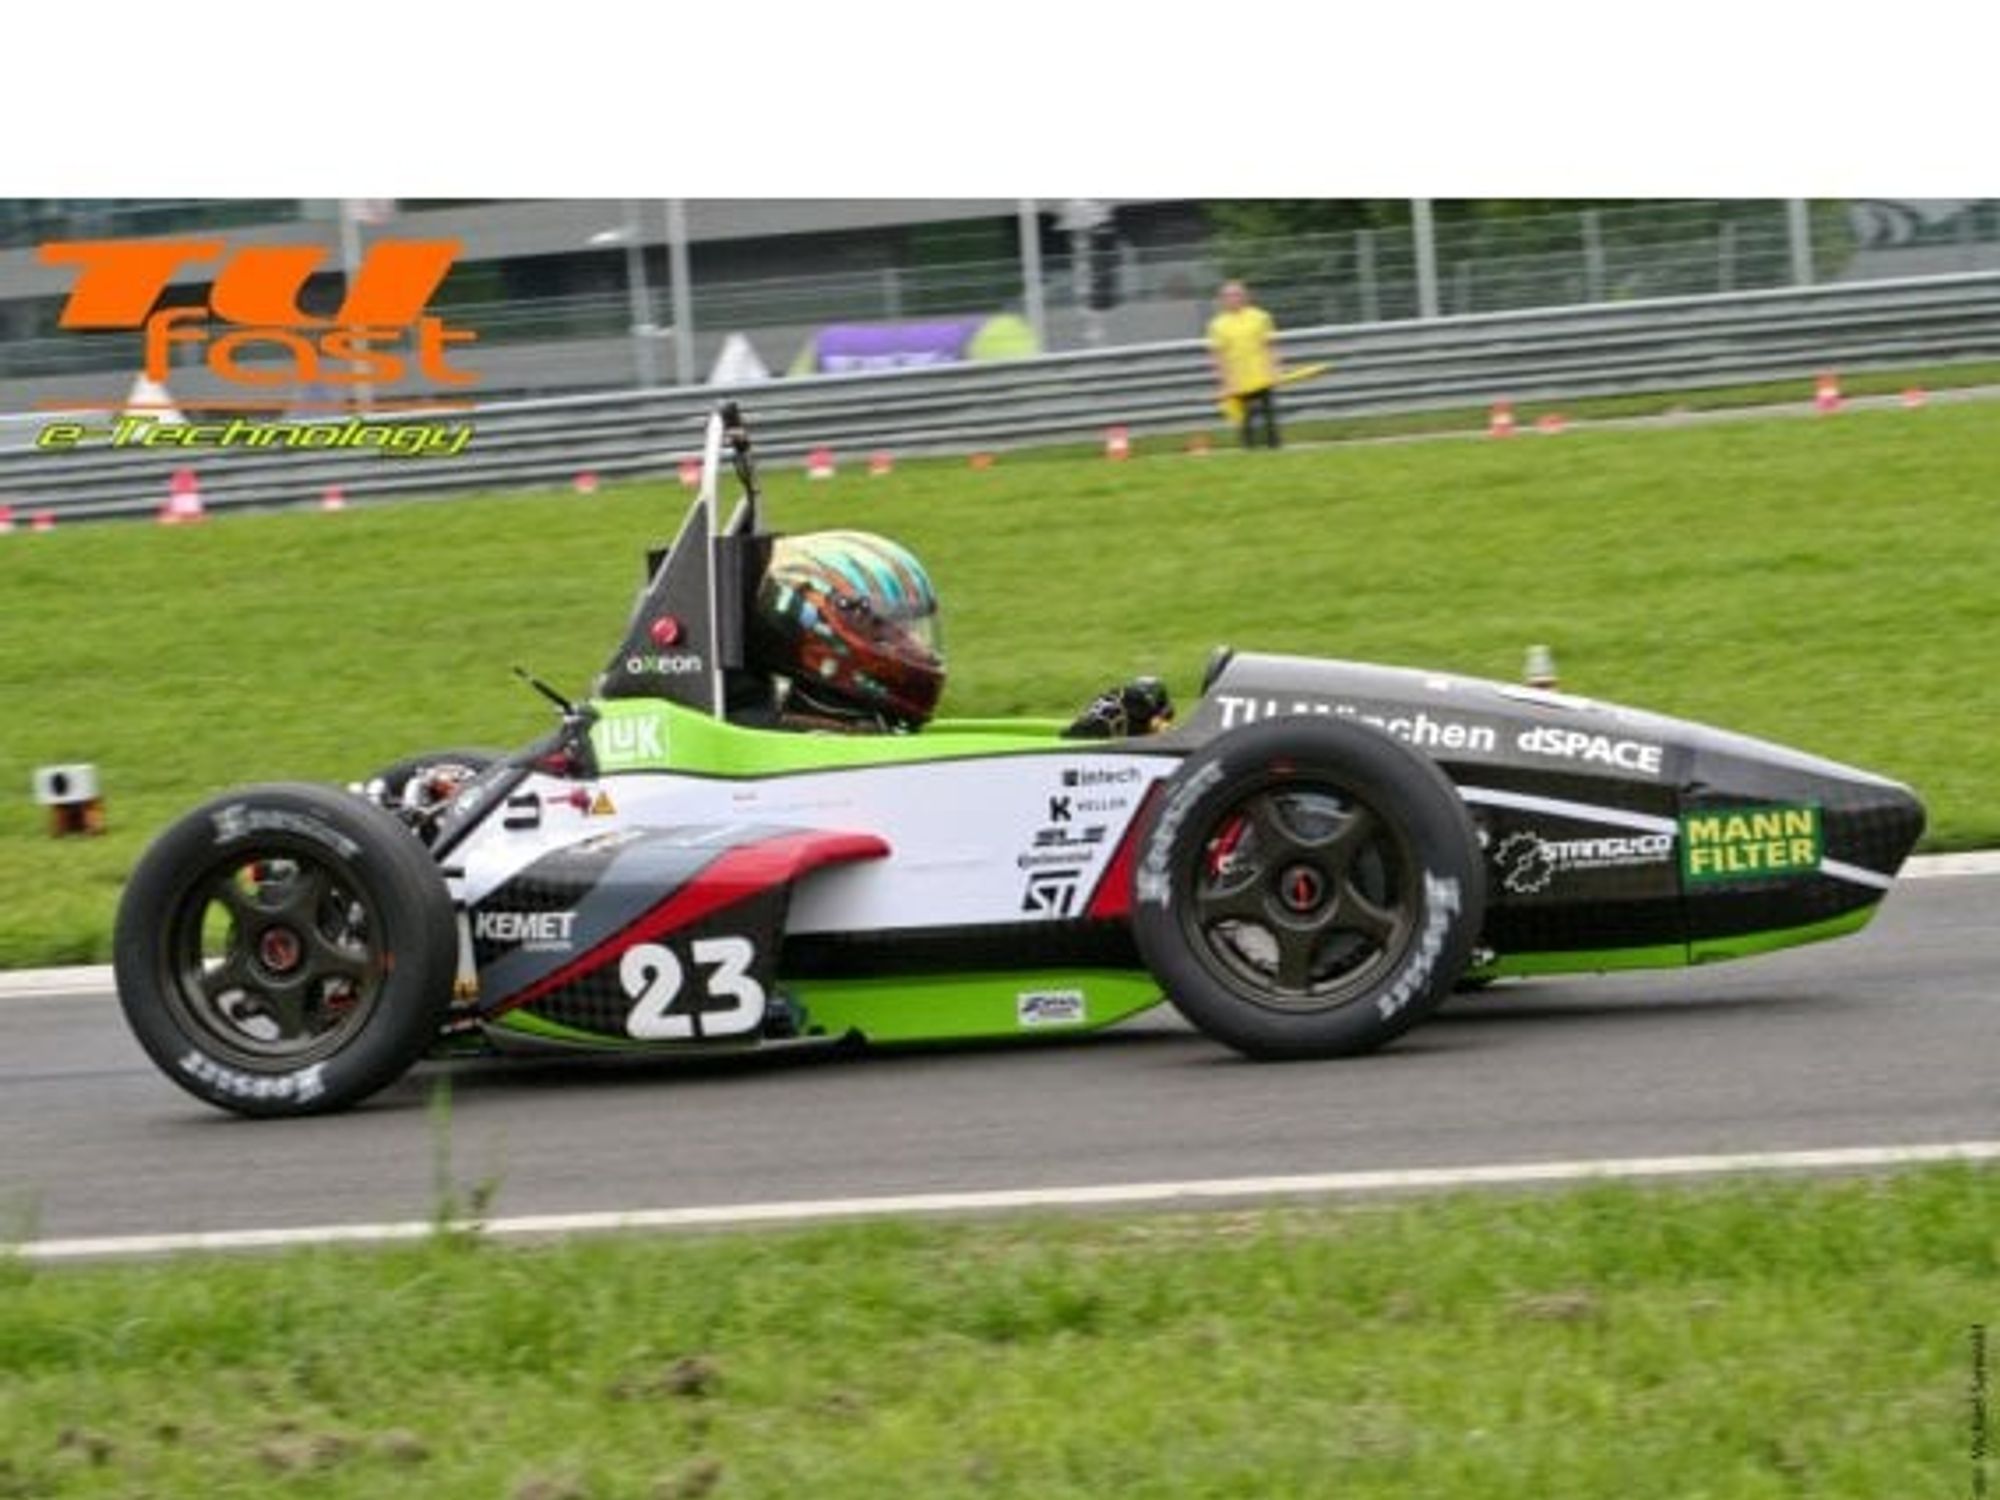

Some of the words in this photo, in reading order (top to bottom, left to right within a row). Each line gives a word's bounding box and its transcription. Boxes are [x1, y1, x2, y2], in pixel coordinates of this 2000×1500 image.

[1517, 727, 1662, 773] dSPACE
[1688, 810, 1813, 844] MANN
[1690, 838, 1816, 875] FILTER
[475, 912, 578, 939] KEMET
[619, 936, 765, 1039] 23
